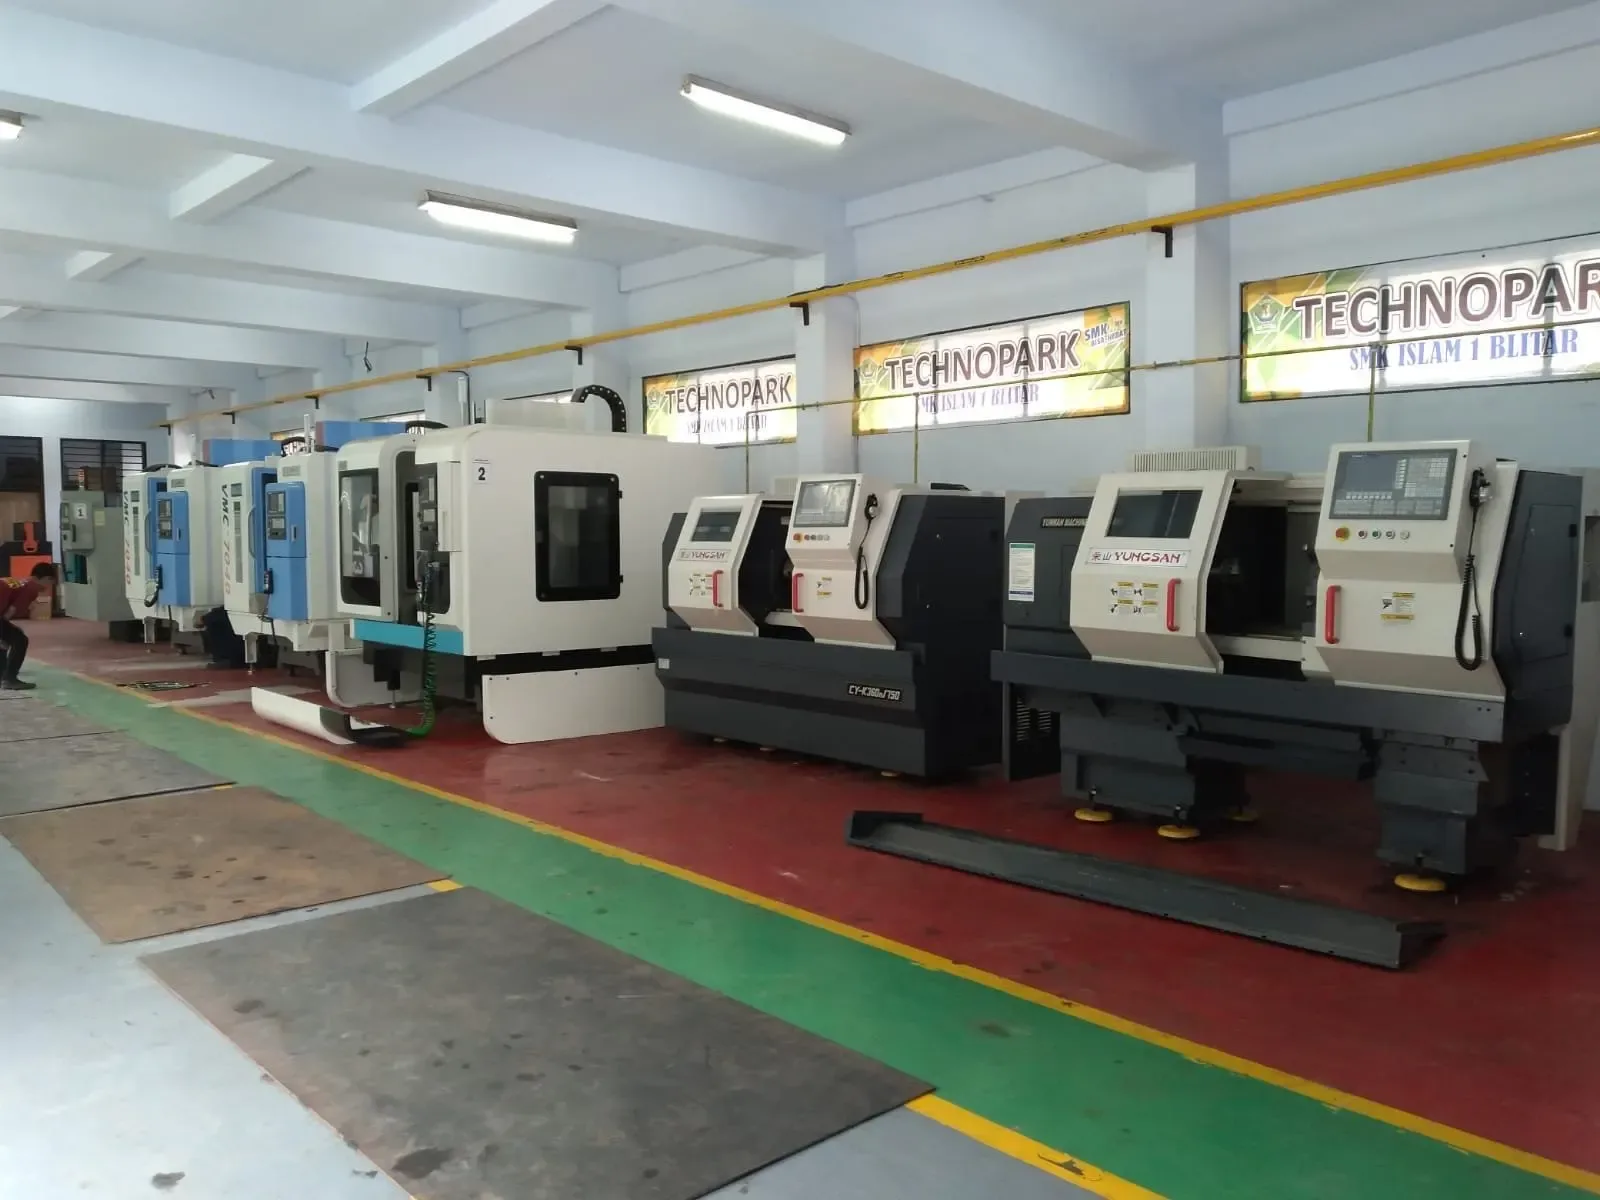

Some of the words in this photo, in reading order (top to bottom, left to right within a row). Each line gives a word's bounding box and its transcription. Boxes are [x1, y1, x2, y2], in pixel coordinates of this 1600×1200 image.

[885, 332, 1080, 390] TECHNOPARK
[1350, 344, 1388, 370] SMK
[1398, 339, 1461, 365] ISLAM
[1471, 338, 1478, 360] 1
[1490, 328, 1578, 359] BLITAR
[666, 375, 792, 414] TECHNOPARK
[478, 466, 486, 481] 2
[77, 507, 84, 517] 1
[1115, 551, 1180, 563] YUNGSAN
